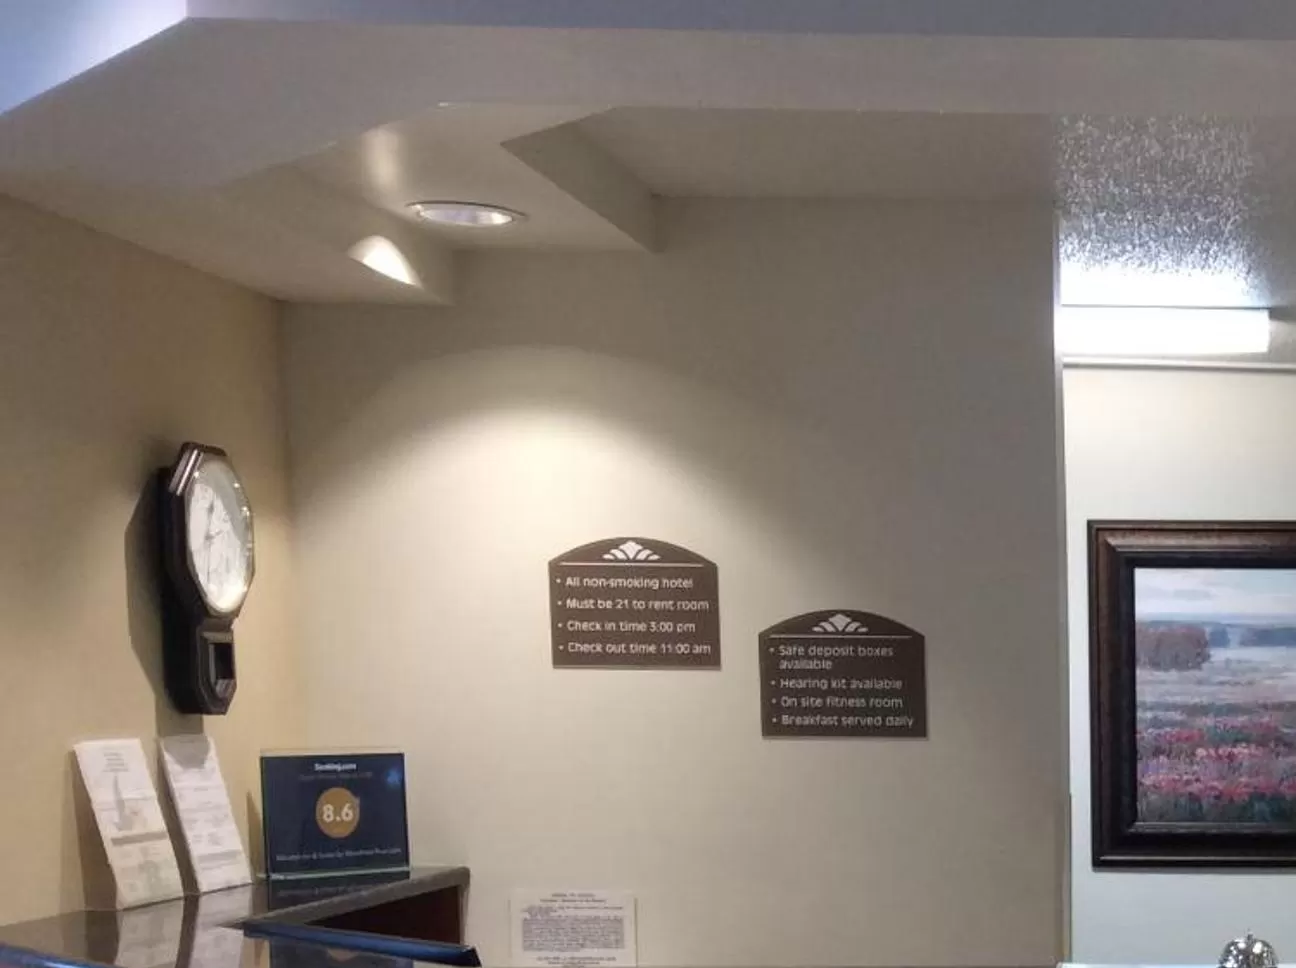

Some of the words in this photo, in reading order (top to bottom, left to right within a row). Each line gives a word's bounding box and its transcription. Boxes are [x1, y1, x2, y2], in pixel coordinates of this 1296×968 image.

[565, 577, 580, 587] All
[583, 577, 659, 589] non-smoking
[662, 578, 693, 588] hotel
[566, 599, 595, 609] Must
[598, 599, 613, 609] be
[616, 599, 629, 609] 21
[632, 600, 645, 610] to
[649, 601, 675, 610] rent
[678, 601, 709, 610] room
[567, 620, 600, 632] Check
[605, 621, 616, 631] in
[620, 621, 647, 632] time
[650, 622, 673, 632] 3:00
[676, 623, 695, 633] pm
[568, 642, 602, 653] Check
[606, 643, 626, 654] out
[630, 643, 656, 654] time
[692, 644, 711, 654] am
[779, 645, 804, 656] Safe
[808, 645, 854, 659] deposit
[858, 645, 893, 656] boxes
[779, 658, 832, 670] available
[780, 678, 828, 690] Hearing
[831, 678, 846, 689] kit
[850, 679, 902, 689] available
[780, 697, 797, 708] On
[801, 697, 823, 708] site
[827, 696, 866, 708] fitness
[869, 698, 904, 708] room
[781, 715, 839, 726] Breakfast
[841, 715, 882, 726] served
[886, 716, 913, 728] daily
[322, 803, 354, 823] 8.6
